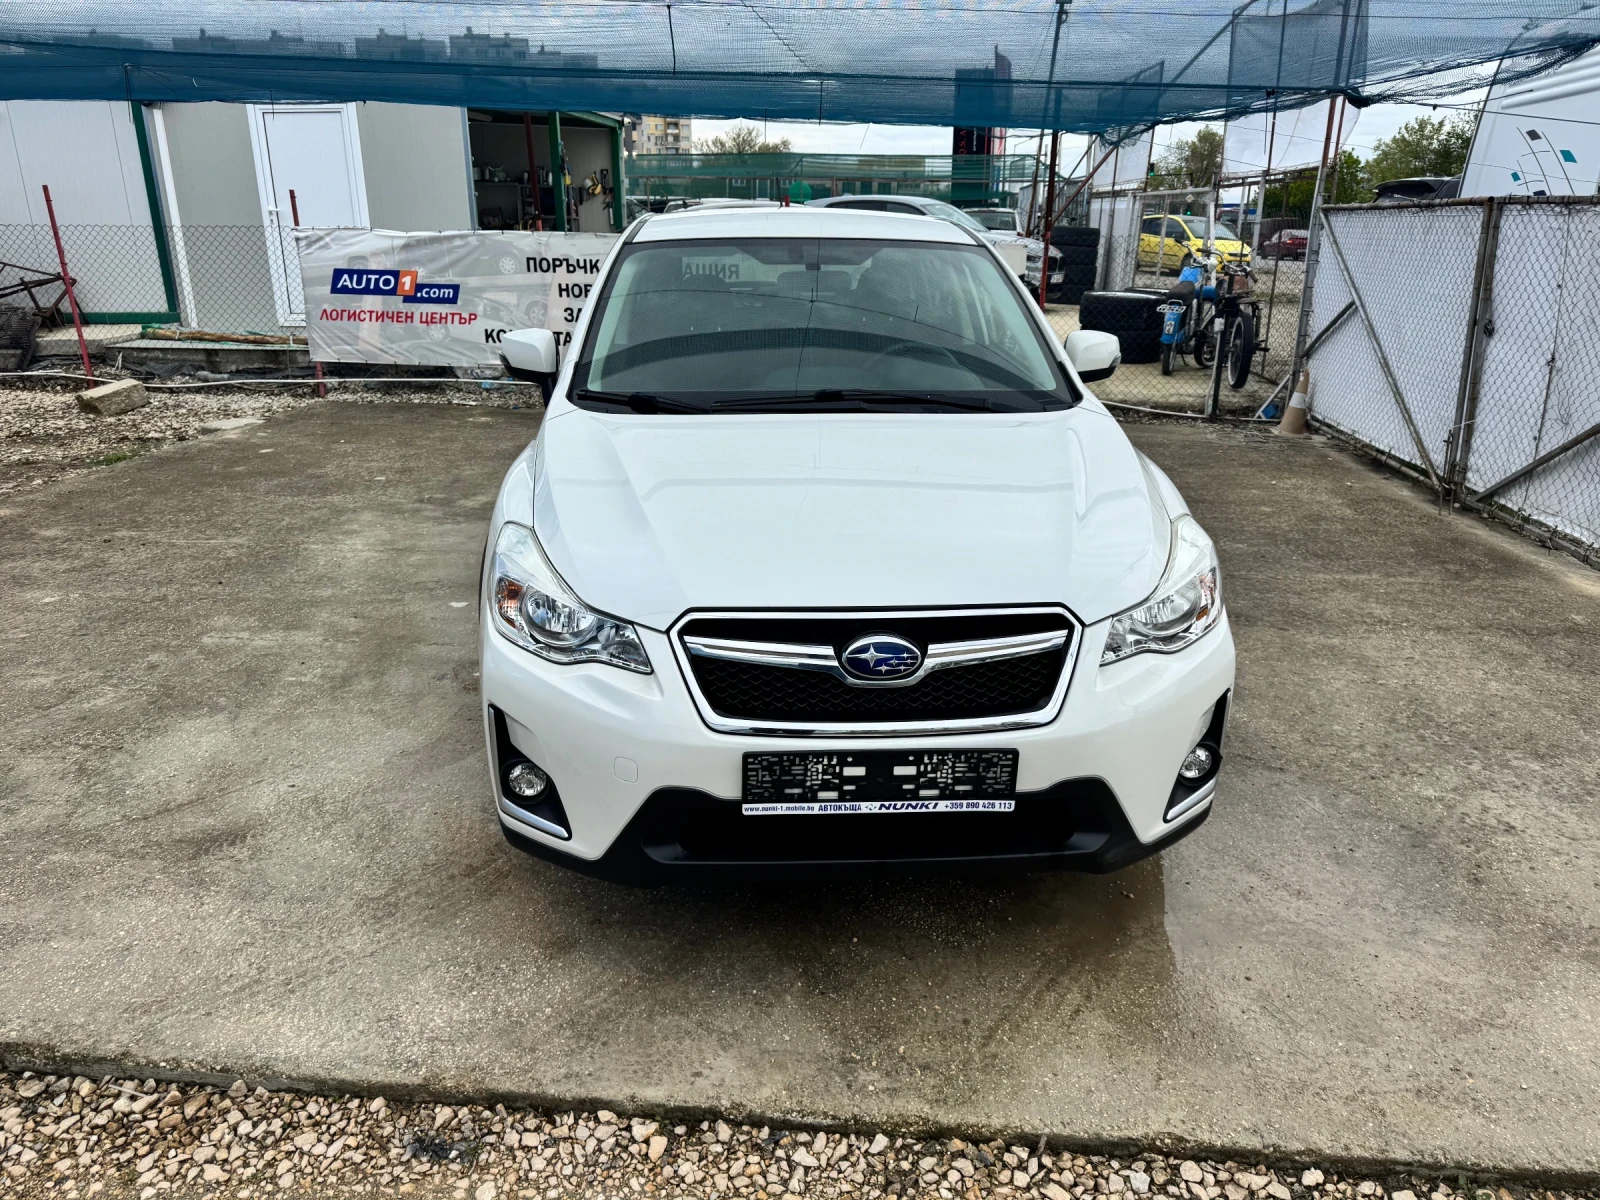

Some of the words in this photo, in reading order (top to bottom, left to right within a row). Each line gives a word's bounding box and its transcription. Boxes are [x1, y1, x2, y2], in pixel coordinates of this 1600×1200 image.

[319, 308, 414, 324] ЛОГИСТИЧЕН
[419, 311, 478, 327] ЦЕНТЪР
[743, 804, 815, 813] www.nunki-1.mobile.bg
[817, 803, 862, 813] АВТОКЪЩА
[878, 801, 939, 811] NUNKI
[944, 801, 964, 810] +359
[965, 801, 980, 810] 890
[981, 801, 996, 810] 426
[997, 801, 1013, 810] 113
